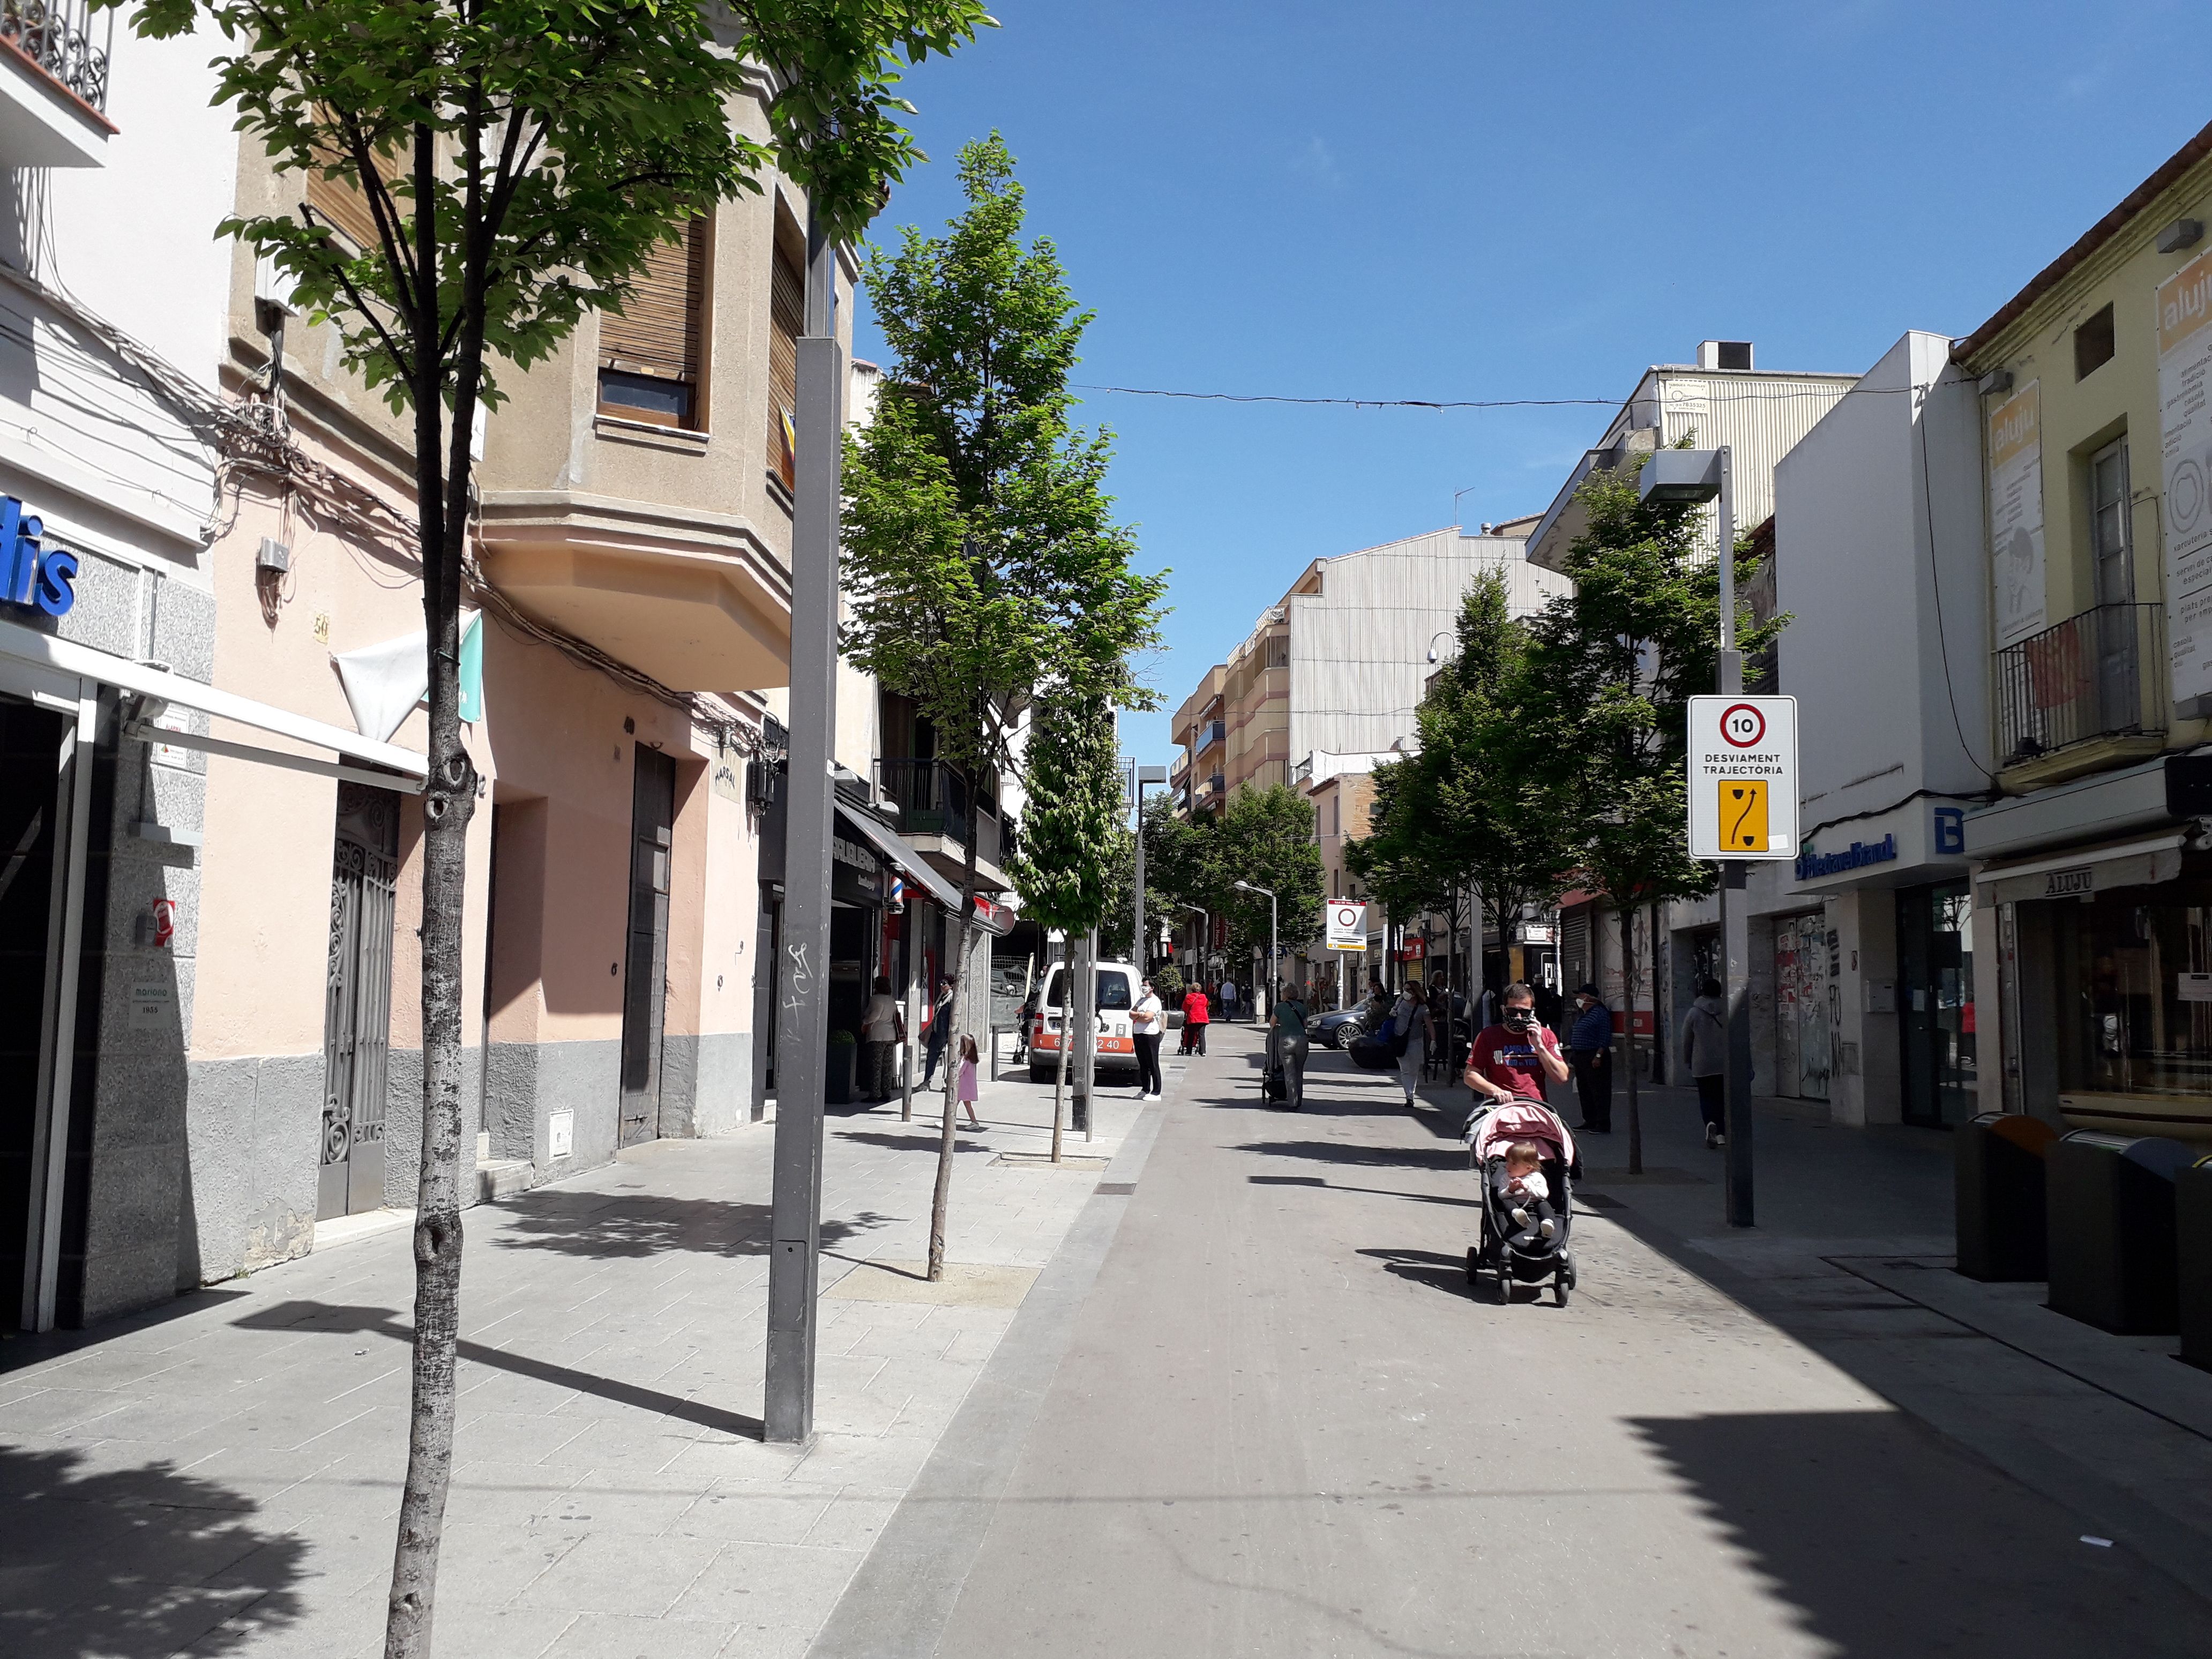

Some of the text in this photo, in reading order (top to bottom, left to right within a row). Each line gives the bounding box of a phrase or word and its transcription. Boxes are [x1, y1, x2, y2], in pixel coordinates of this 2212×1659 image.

[1995, 406, 2035, 451] aluju
[2196, 558, 2204, 568] de
[1732, 719, 1753, 733] 10
[1705, 754, 1780, 763] DESVIAMENT
[1703, 764, 1783, 774] TRAJECTÒRIA
[1054, 1037, 1072, 1049] 67
[1107, 1040, 1119, 1049] 40
[1525, 1058, 1537, 1066] YOU
